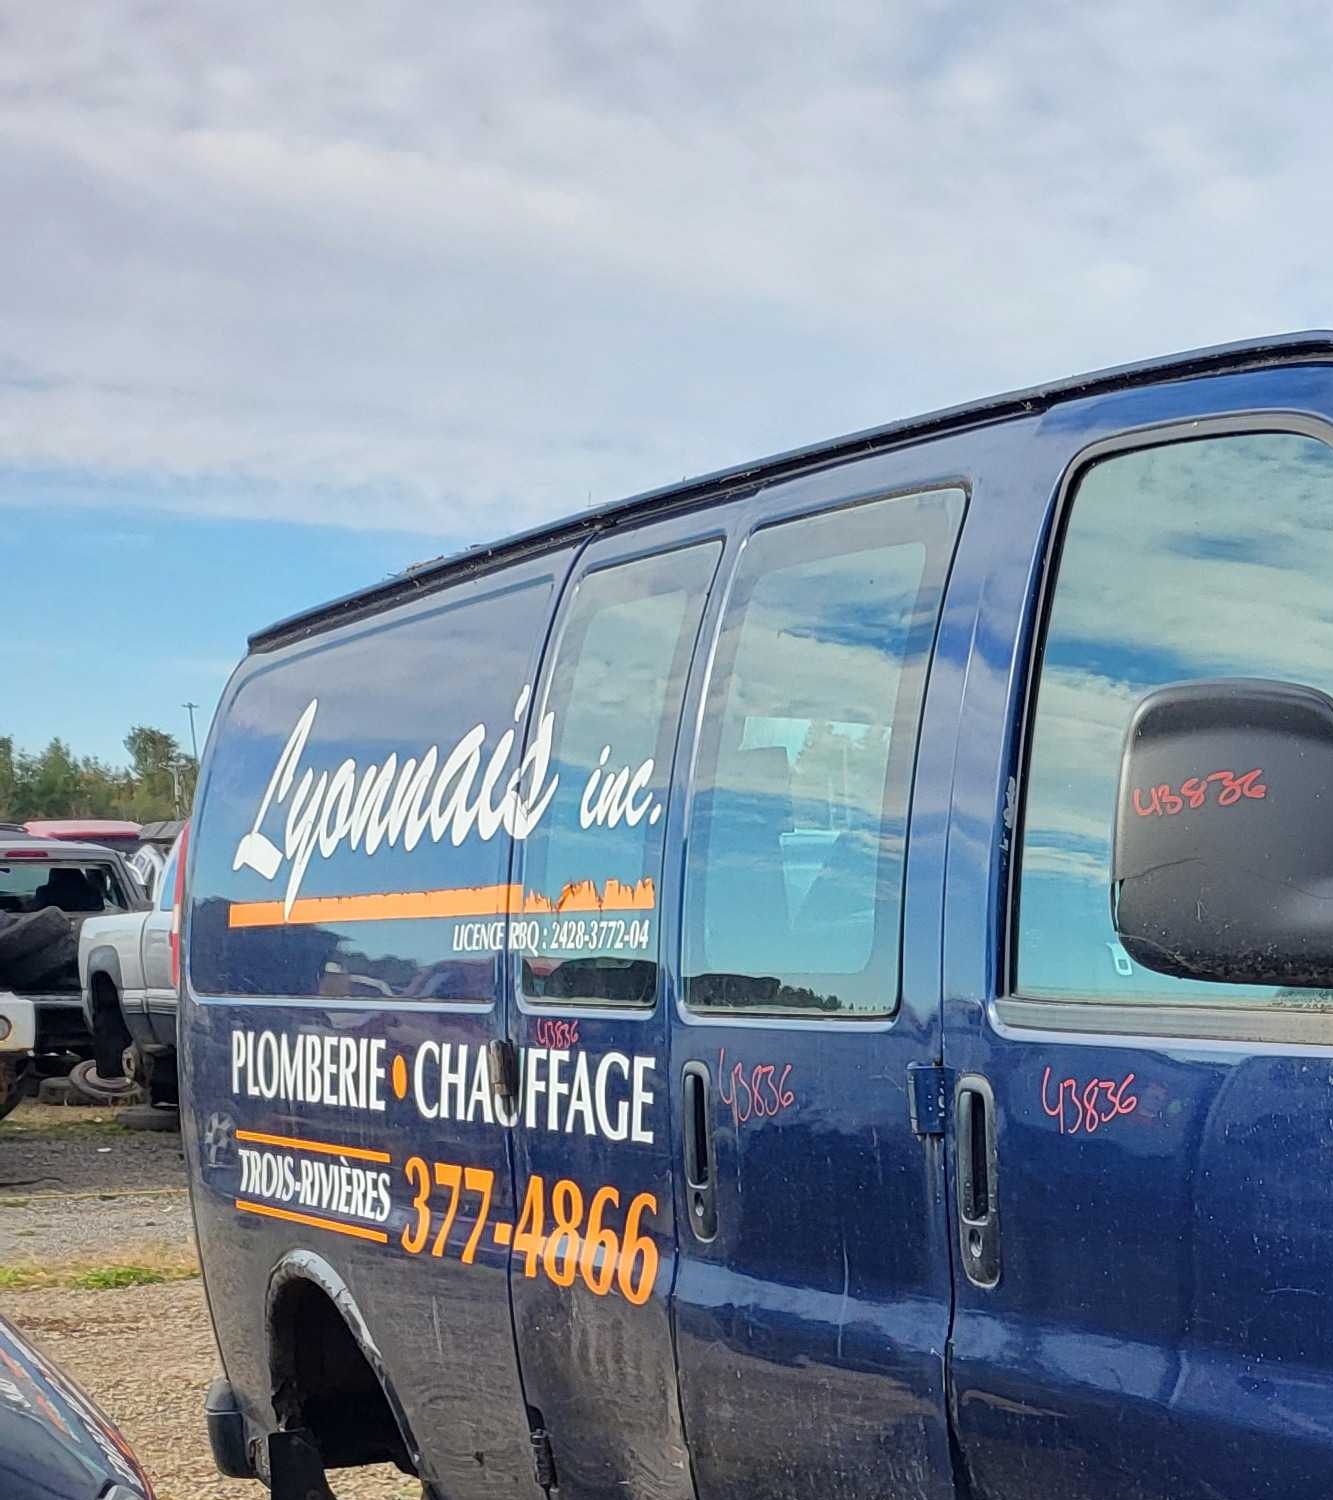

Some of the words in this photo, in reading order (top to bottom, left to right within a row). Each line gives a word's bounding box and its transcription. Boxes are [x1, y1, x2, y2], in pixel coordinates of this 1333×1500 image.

[232, 684, 558, 924] Lyonnais
[579, 745, 664, 829] inc.
[1132, 767, 1268, 819] 43836
[453, 922, 503, 950] LICENCE
[509, 921, 540, 956] RBQ
[550, 919, 649, 950] 2428-3772-04
[230, 1029, 386, 1112] PLOMBERIE
[718, 1047, 794, 1127] 43836
[1042, 1066, 1137, 1134] 43836
[238, 1148, 390, 1222] TROIS-RIVIÈRES
[402, 1156, 659, 1305] 377-4866
